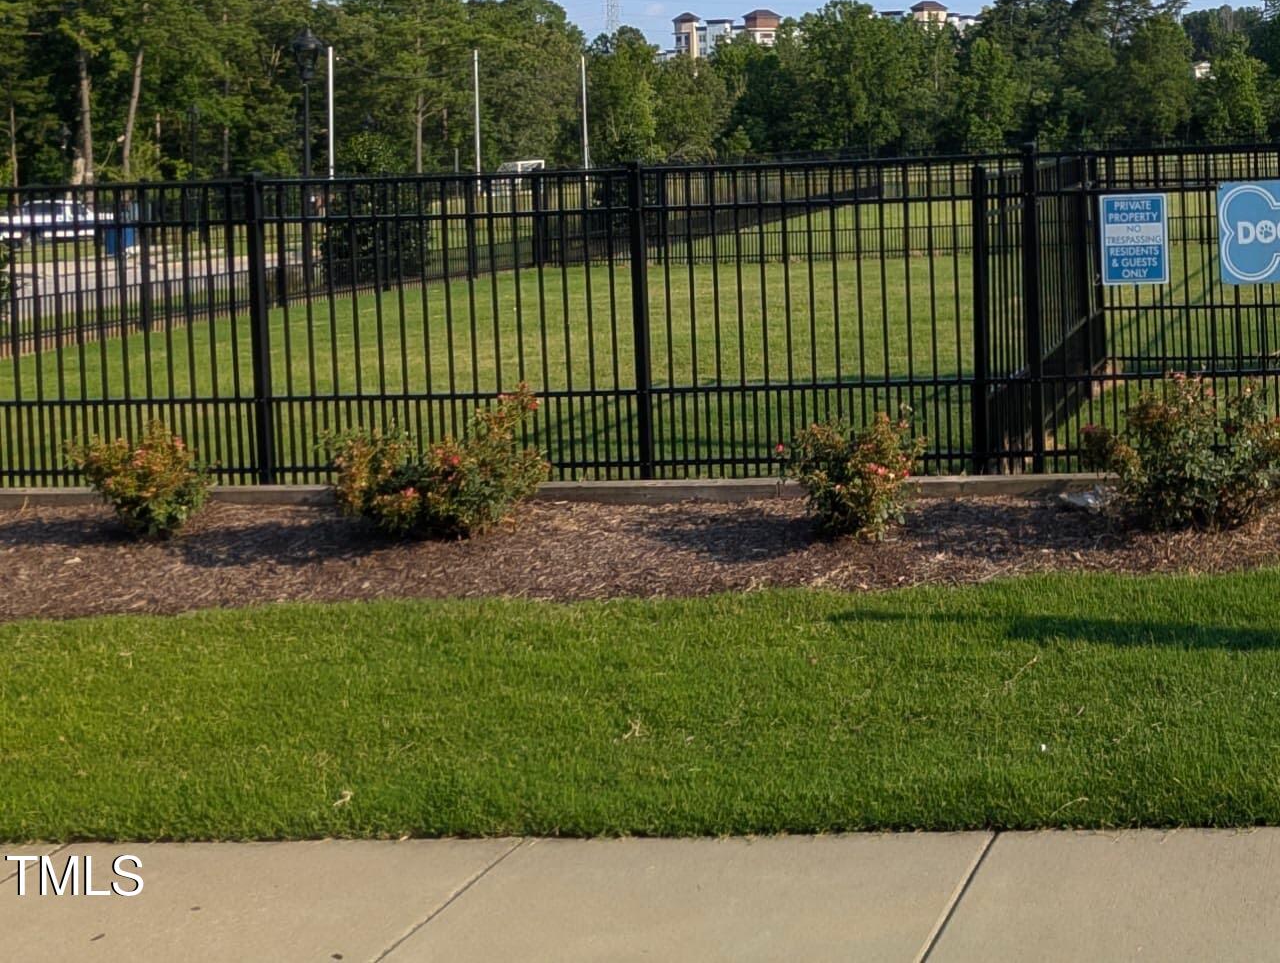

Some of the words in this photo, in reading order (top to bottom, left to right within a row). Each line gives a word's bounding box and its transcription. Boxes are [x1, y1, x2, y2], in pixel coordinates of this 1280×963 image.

[1114, 200, 1152, 211] PRIVATE
[1108, 212, 1158, 223] PROPERTY
[1126, 224, 1142, 233] NO
[1106, 236, 1162, 245] TRESPASSING
[1110, 246, 1160, 256] RESIDENTS
[1112, 258, 1119, 268] &
[1121, 257, 1158, 267] GUESTS
[1121, 268, 1148, 278] ONLY
